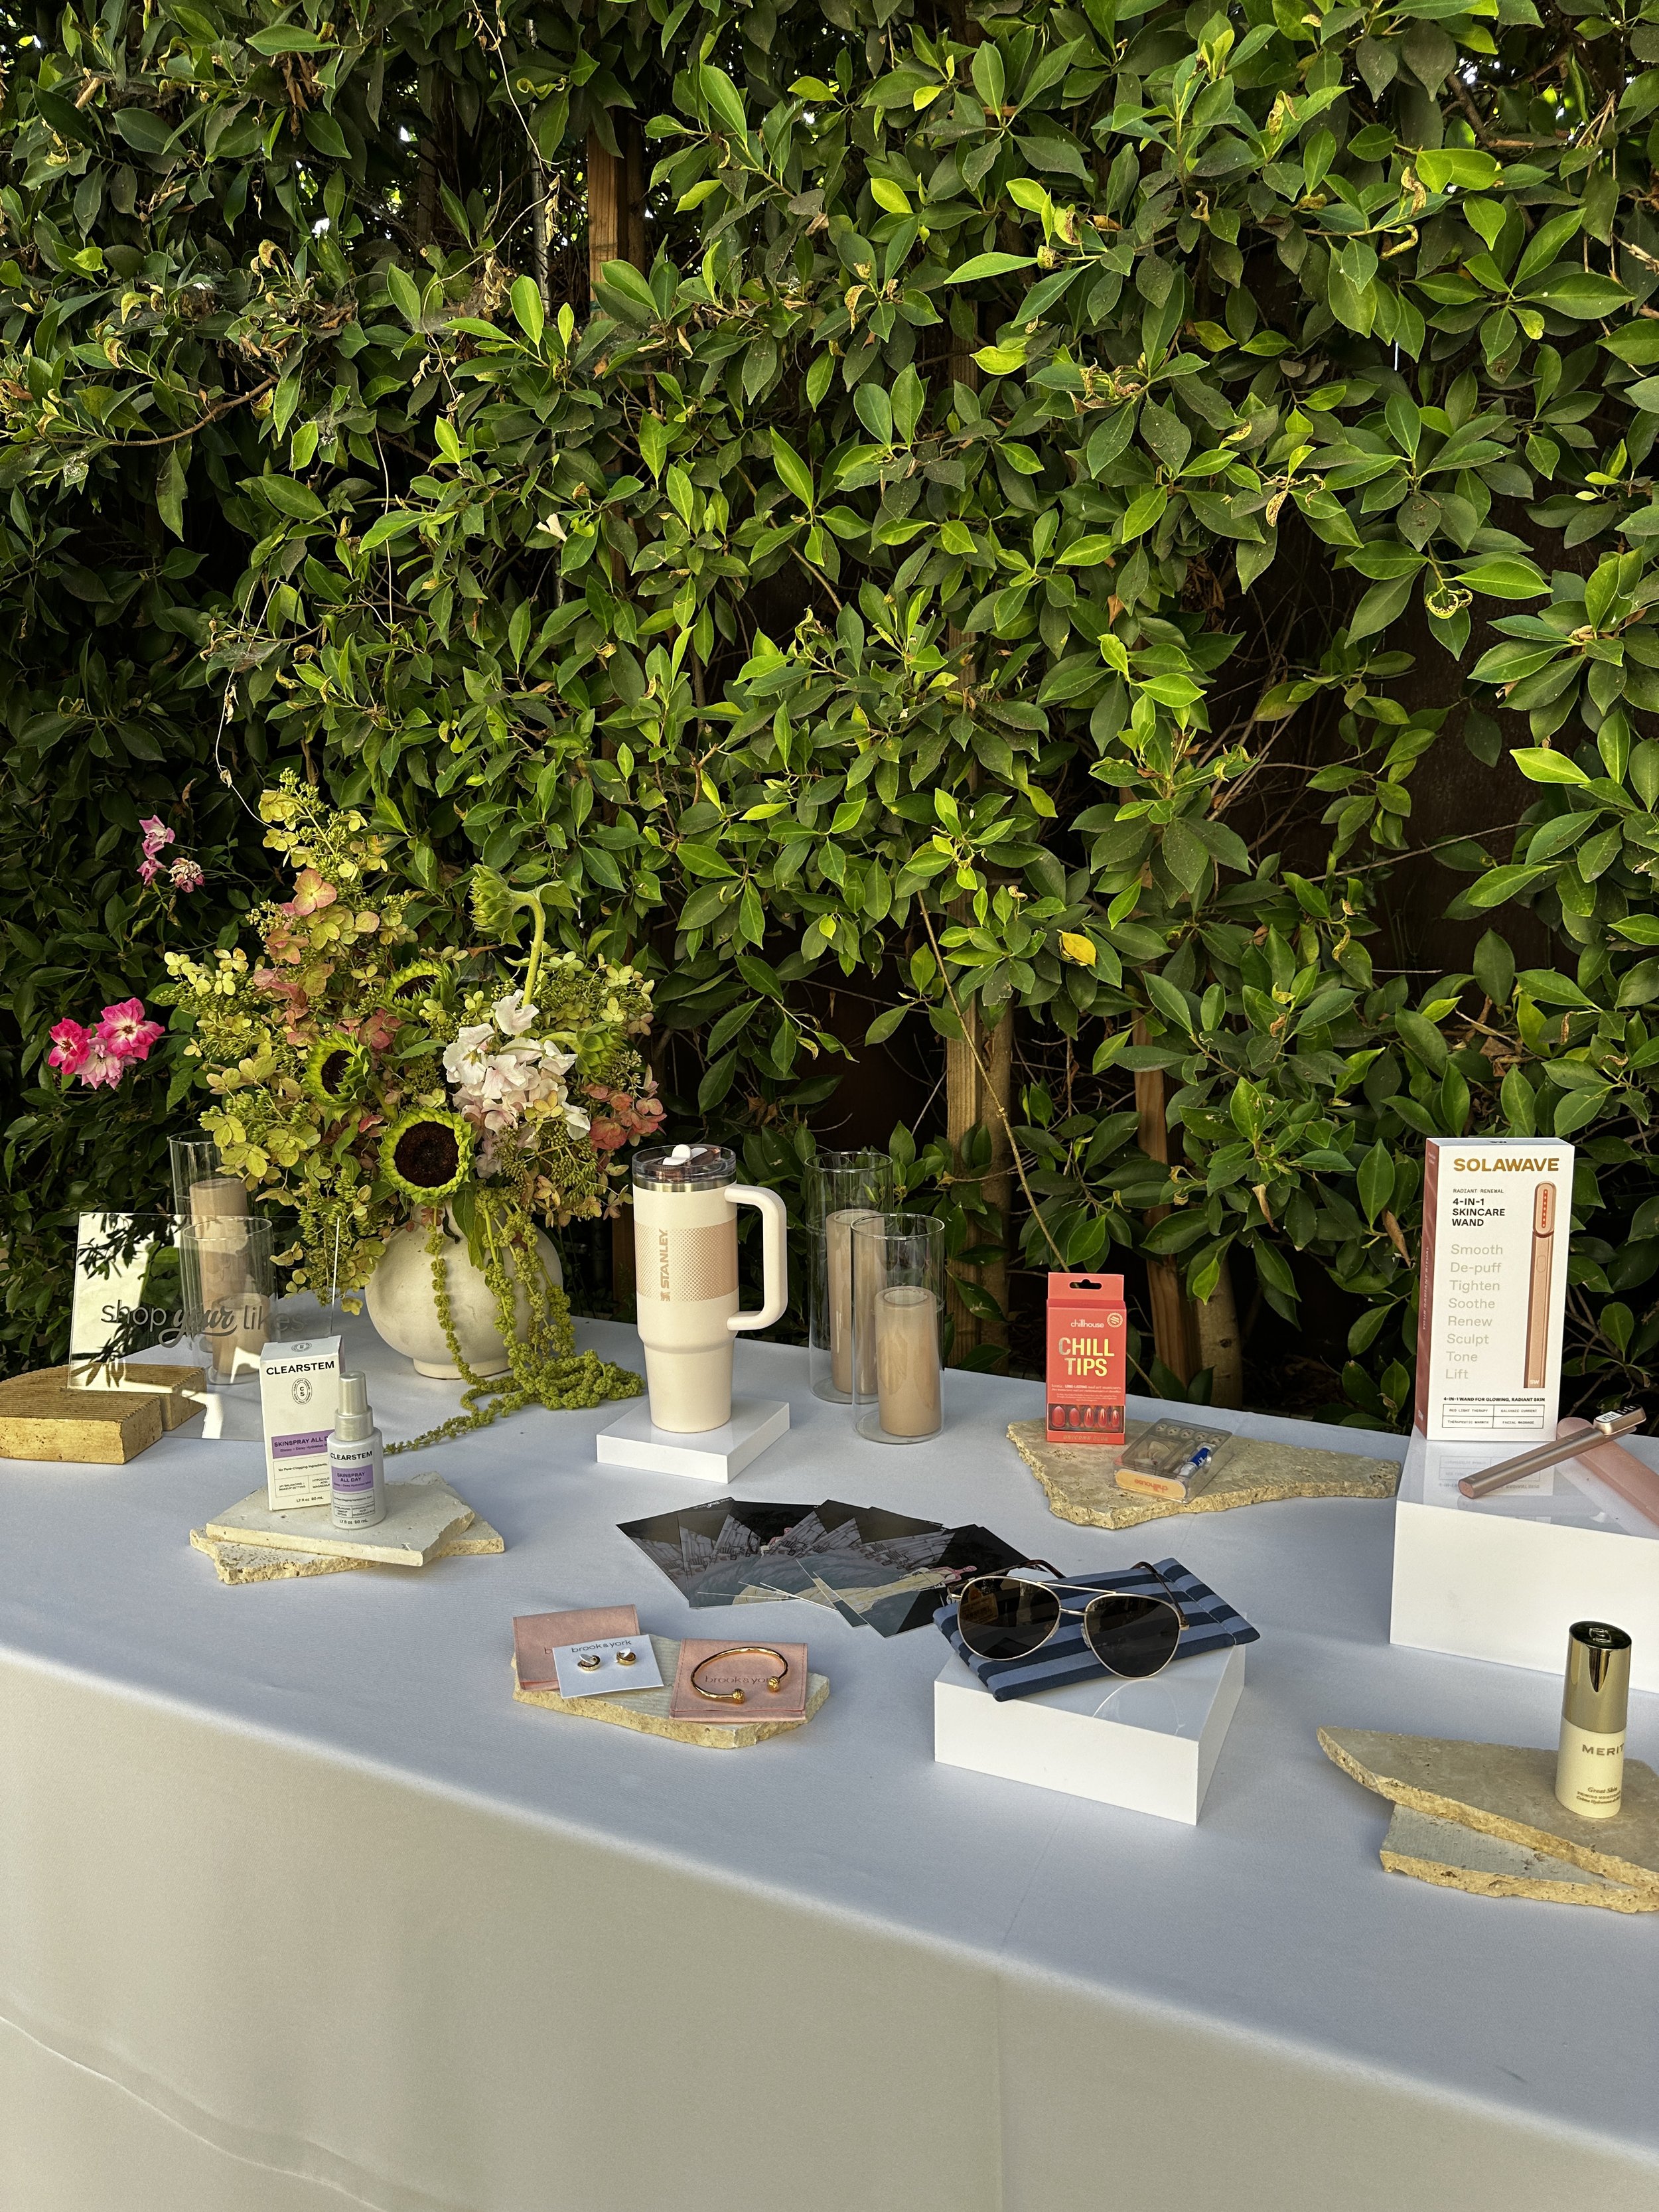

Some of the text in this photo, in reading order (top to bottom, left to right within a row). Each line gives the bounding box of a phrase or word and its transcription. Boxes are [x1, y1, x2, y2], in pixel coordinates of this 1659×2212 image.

[1453, 1158, 1559, 1172] SOLAWAVE
[1451, 1244, 1503, 1255] Smooth
[659, 1228, 670, 1289] STANLEY
[1451, 1262, 1502, 1275] De-puff
[1449, 1280, 1500, 1293] Tighten
[1448, 1298, 1495, 1309] Soothe
[101, 1299, 305, 1348] shop your likes
[1070, 1319, 1104, 1328] chillhouse
[1448, 1316, 1492, 1326] Renew
[1447, 1333, 1489, 1347] Sculpt
[1058, 1337, 1115, 1357] CHILL
[1446, 1351, 1478, 1362] Tone
[266, 1361, 334, 1375] CLEARSTEM
[1064, 1357, 1108, 1376] TIPS
[1445, 1369, 1469, 1379] Lift
[274, 1439, 309, 1447] SKINSPRAY
[330, 1451, 372, 1461] CLEARSTEM
[1134, 1479, 1168, 1493] chillhouse
[1582, 1743, 1624, 1756] MERIT
